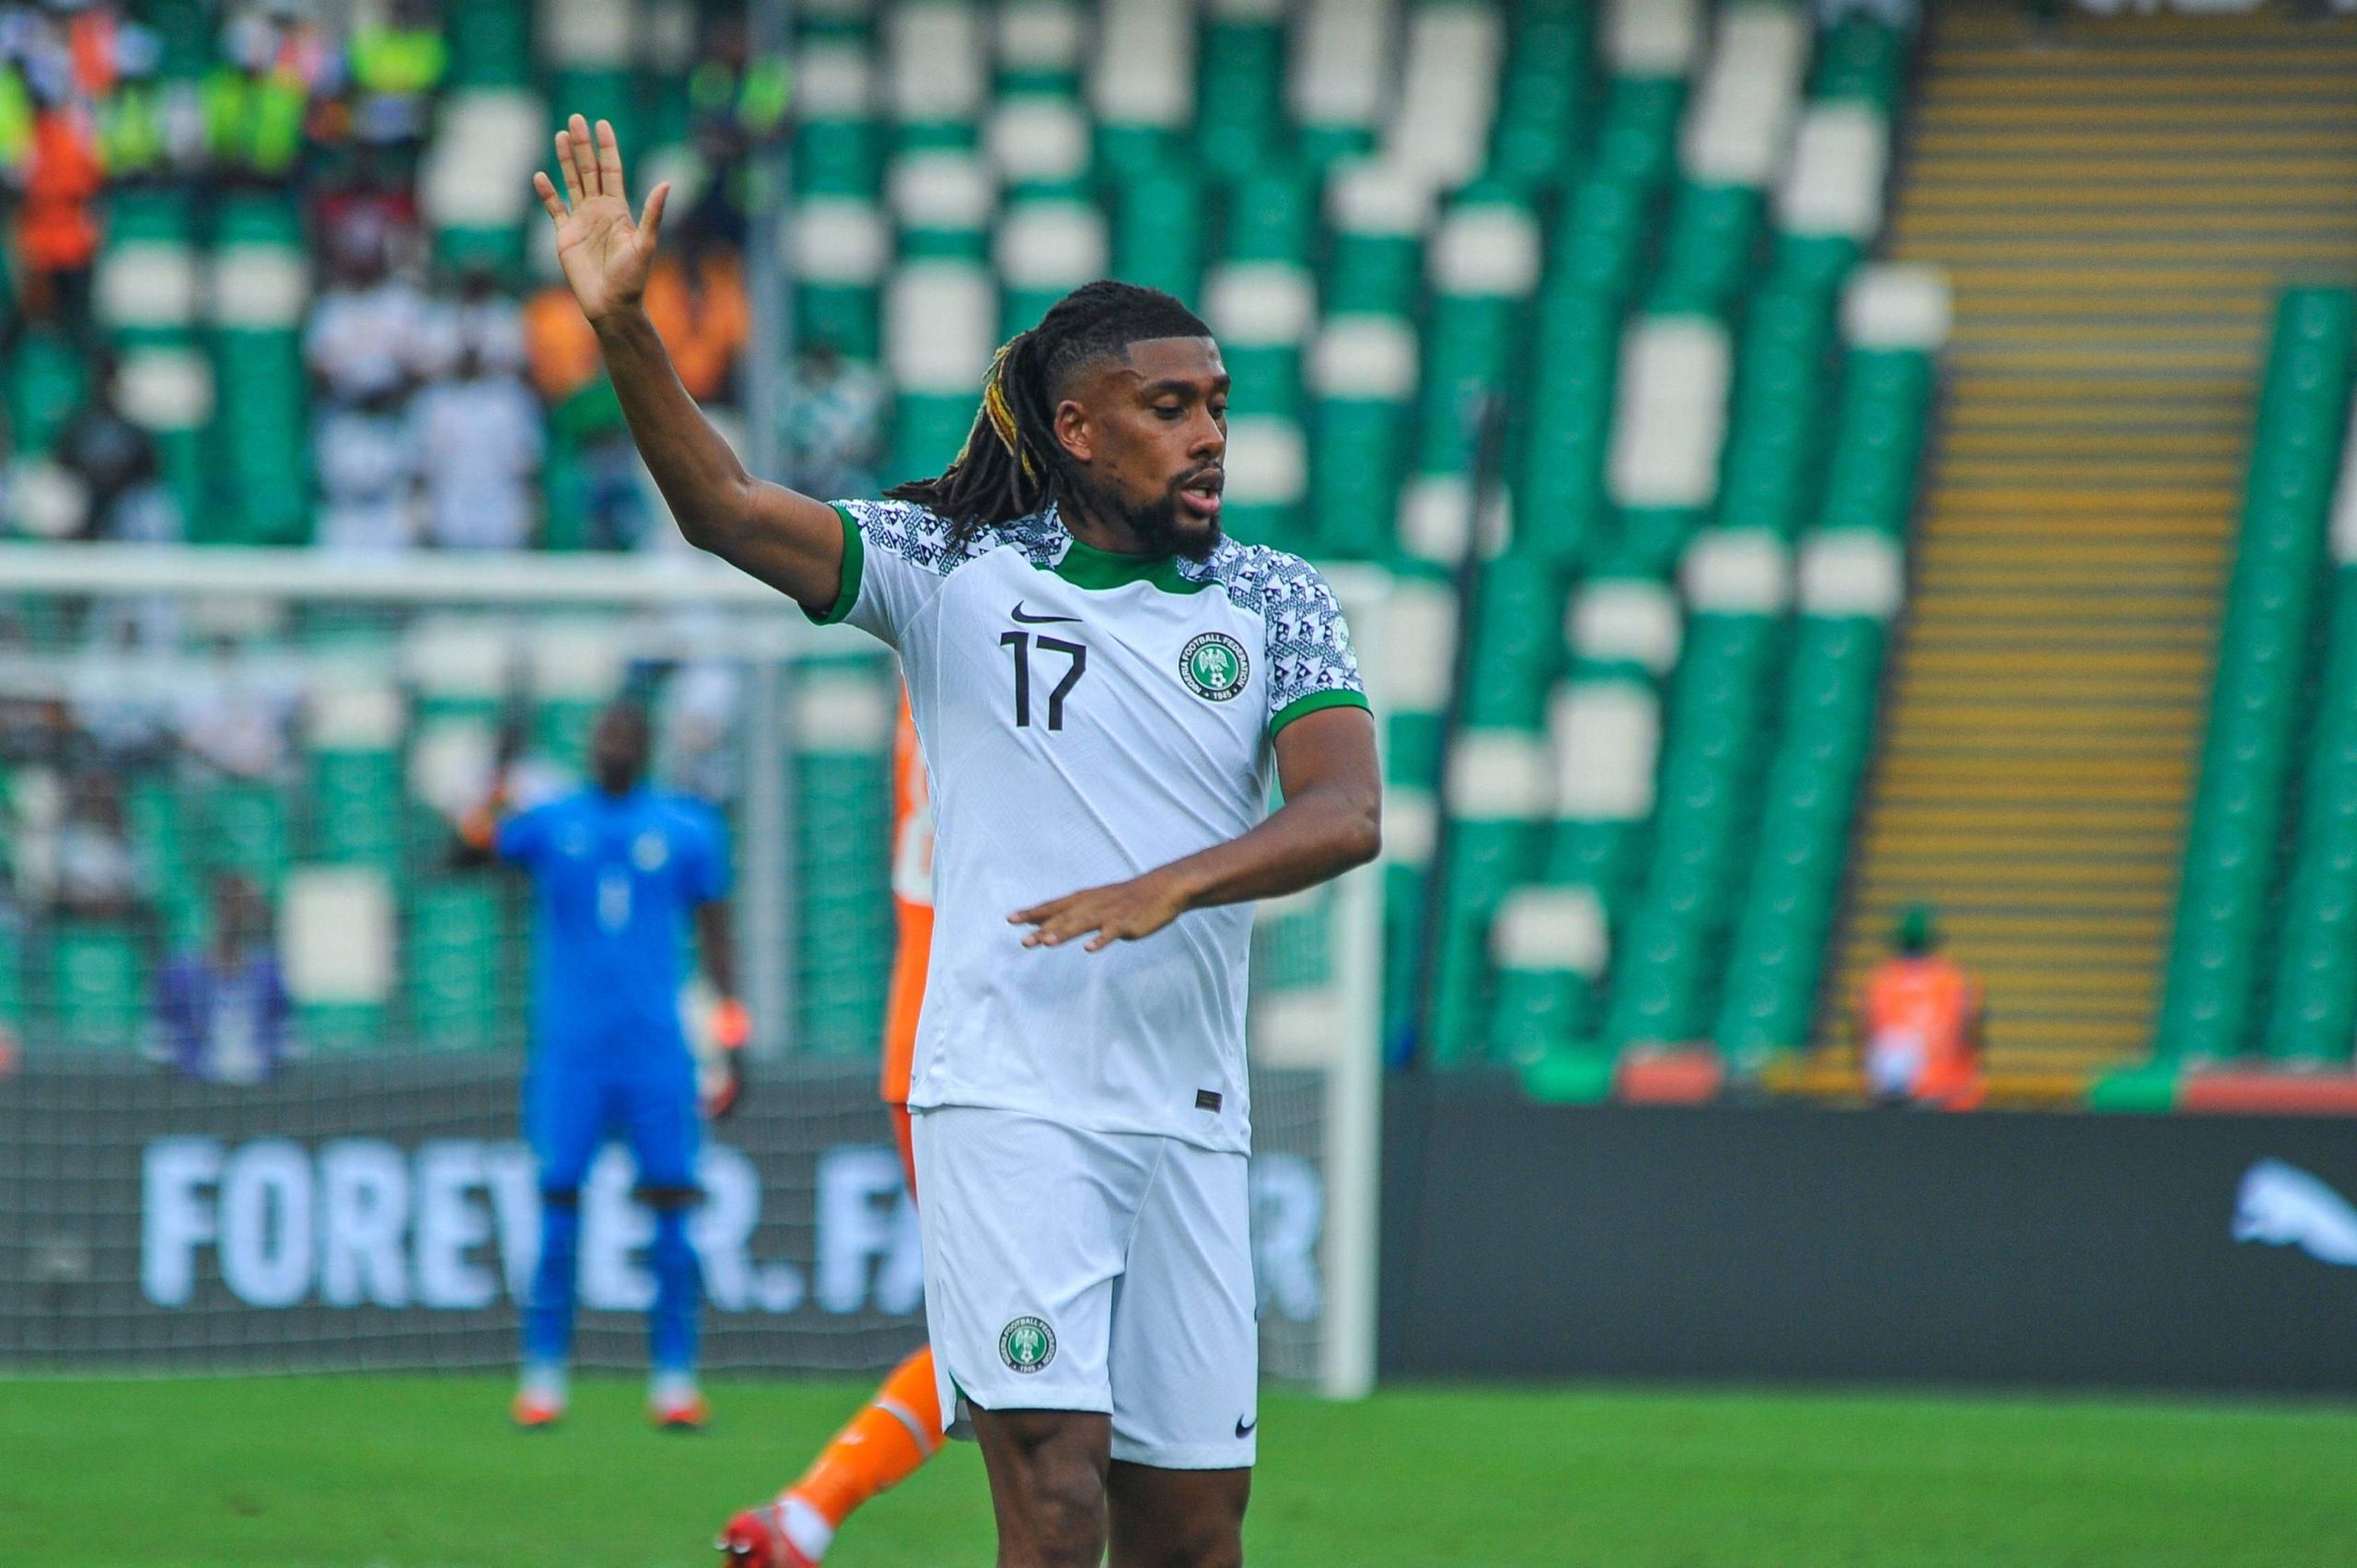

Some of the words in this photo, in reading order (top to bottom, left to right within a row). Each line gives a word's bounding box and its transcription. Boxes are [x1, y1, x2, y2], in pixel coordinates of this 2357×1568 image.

[1182, 633, 1223, 661] FOOTBALL
[1223, 637, 1248, 688] FEDERATION
[1000, 631, 1086, 731] 17
[1180, 661, 1202, 693] NIGERIA
